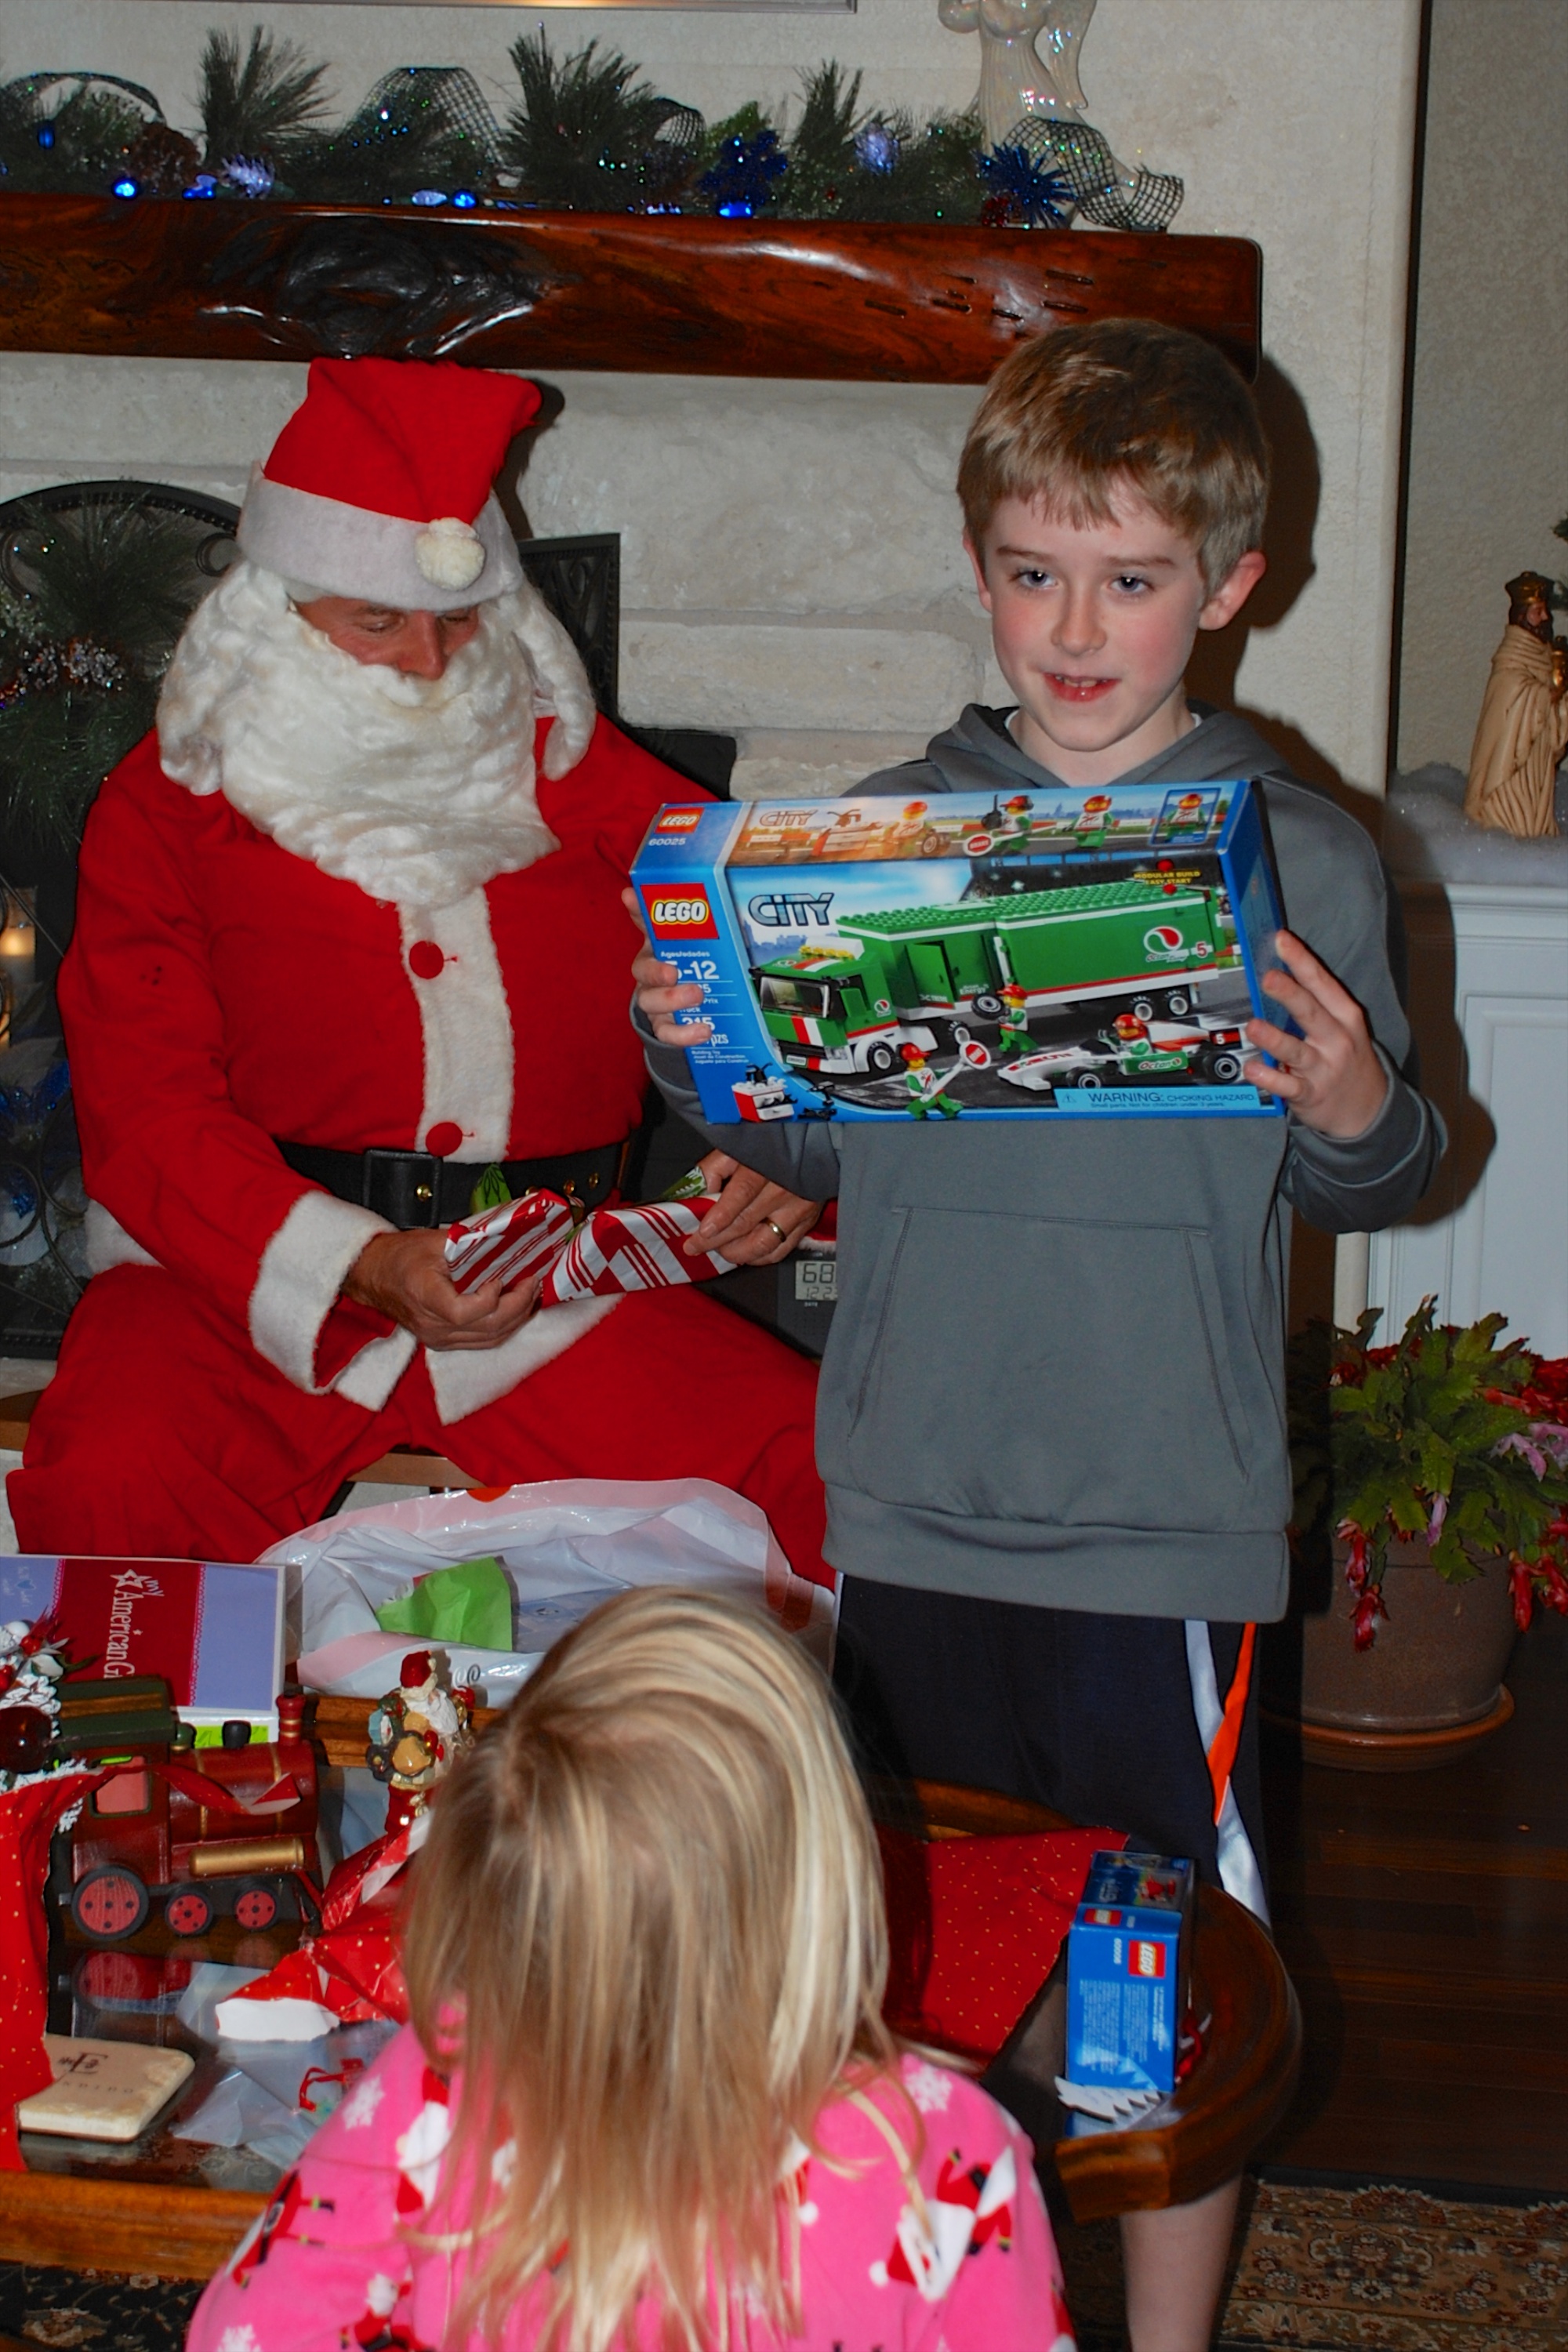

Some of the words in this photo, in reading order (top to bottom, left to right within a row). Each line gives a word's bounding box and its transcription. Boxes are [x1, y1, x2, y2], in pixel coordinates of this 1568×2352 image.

[659, 814, 700, 827] LEGO
[648, 837, 687, 847] 60025
[653, 901, 708, 924] LEGO
[1196, 942, 1208, 958] 5
[1216, 1033, 1225, 1045] 5
[1088, 1092, 1165, 1103] WARNING:
[803, 1263, 835, 1283] 68
[143, 1580, 165, 1597] my
[1138, 1941, 1156, 1977] LEGO
